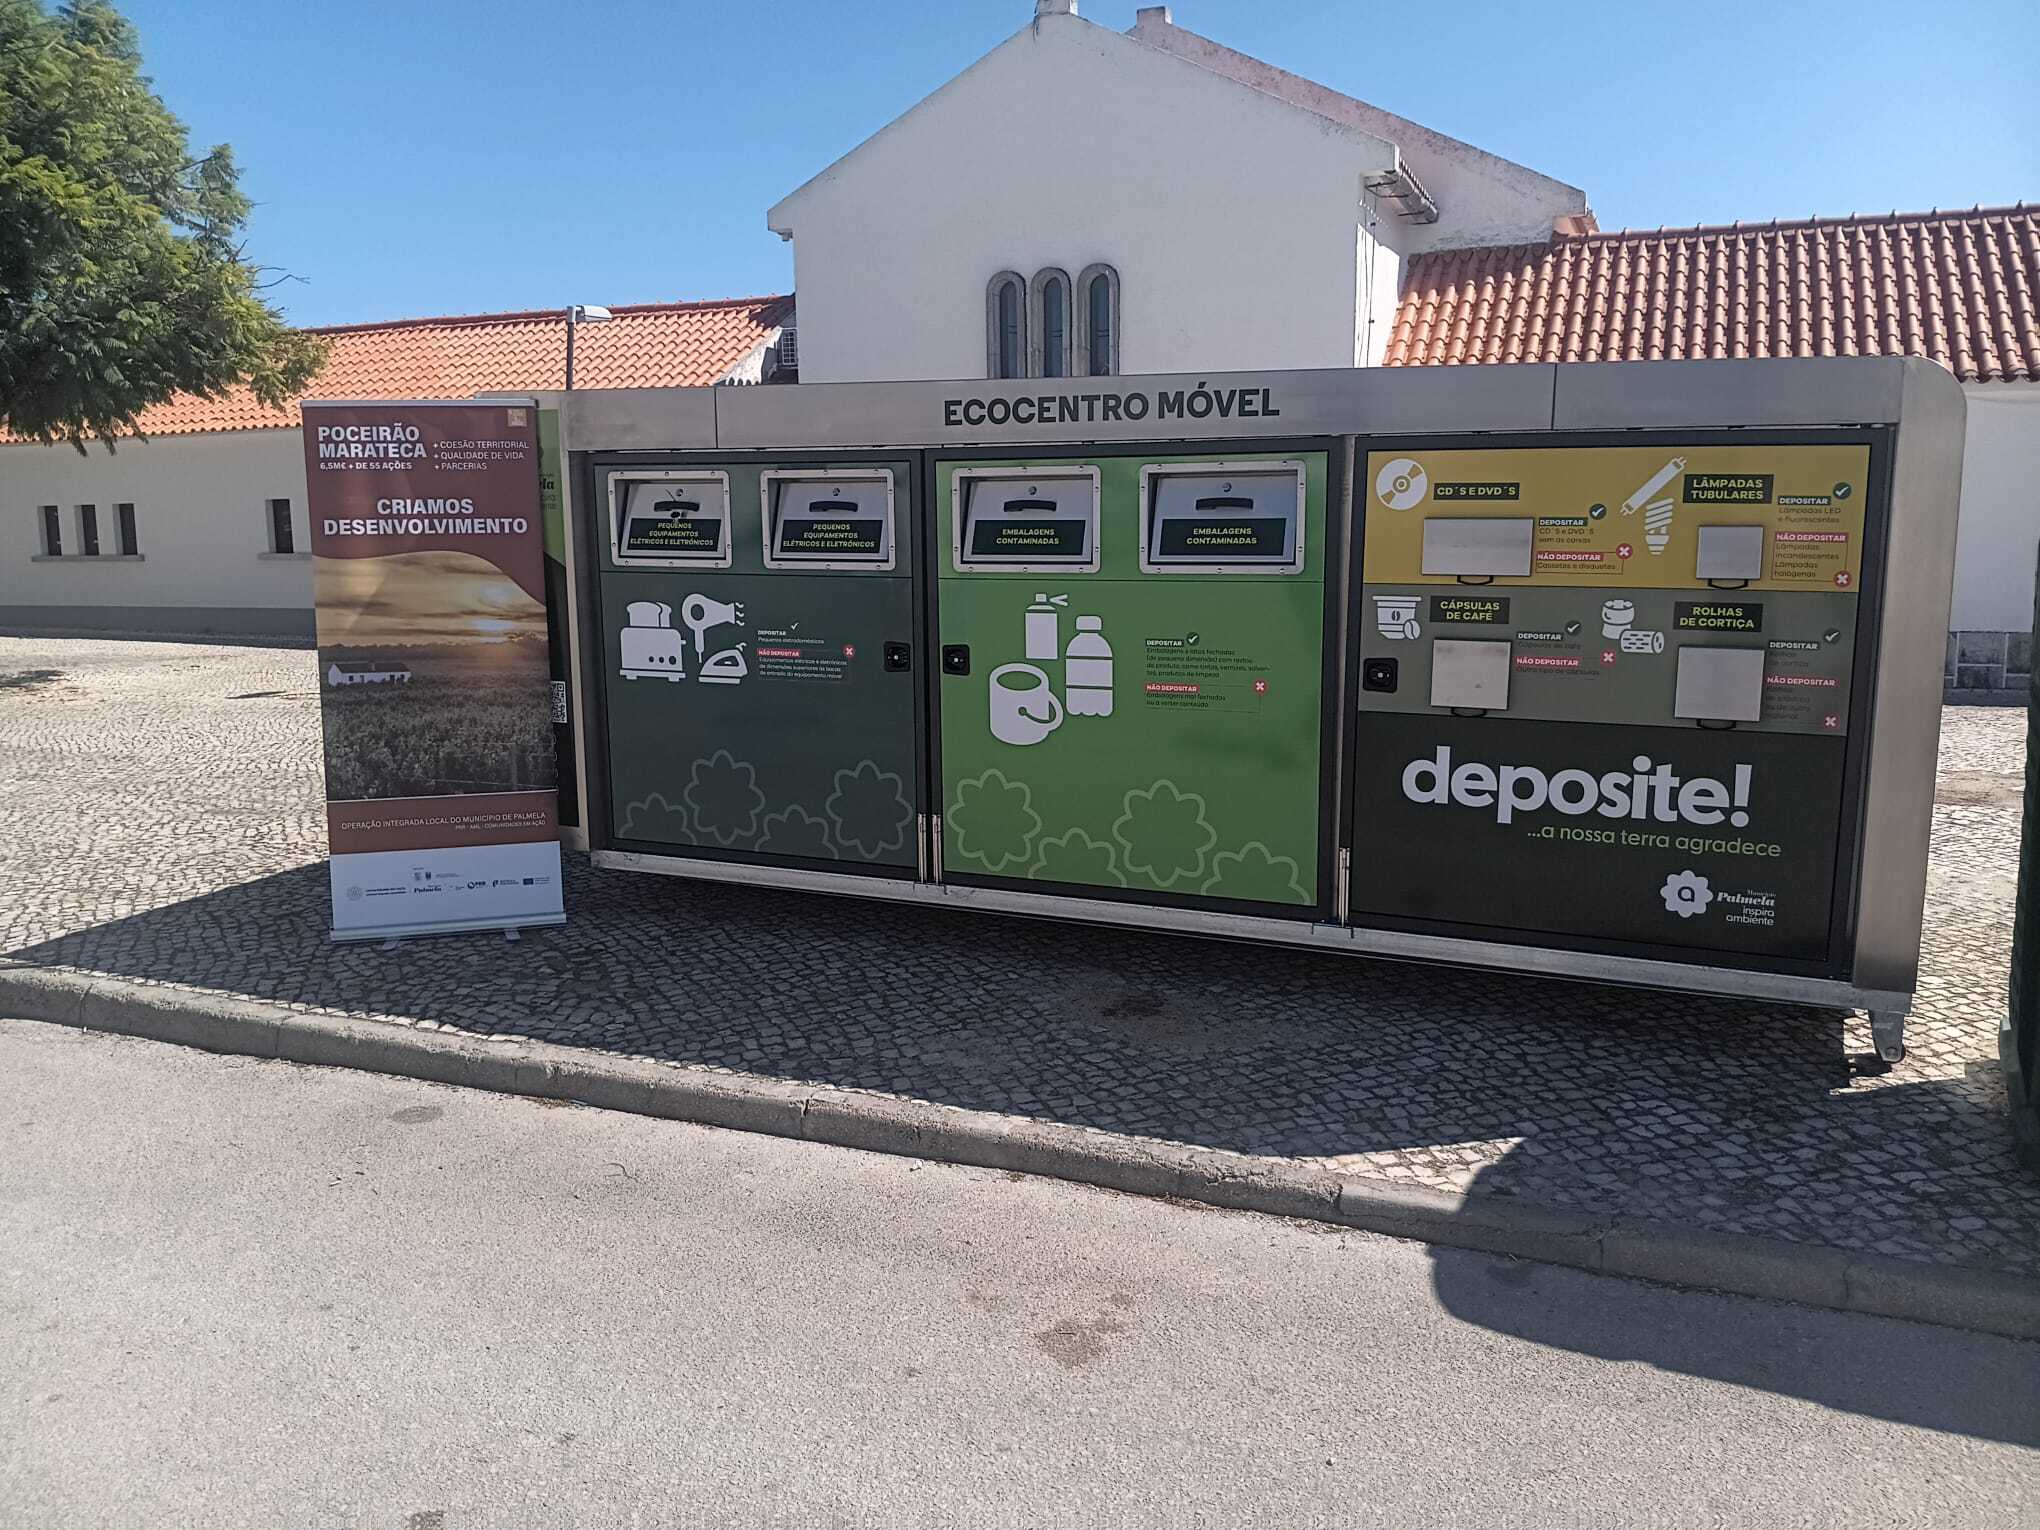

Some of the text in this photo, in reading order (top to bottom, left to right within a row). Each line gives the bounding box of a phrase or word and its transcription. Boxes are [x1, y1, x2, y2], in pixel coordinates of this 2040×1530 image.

[944, 382, 1280, 426] ECOCENTRO MÓVEL
[318, 423, 421, 441] POCEIRÃO
[440, 440, 475, 449] COESÃO
[476, 440, 530, 449] TERRITORIAL
[319, 443, 428, 458] MARATECA
[440, 451, 489, 460] QUALIDADE
[491, 451, 503, 459] DE
[504, 451, 526, 459] VIDA
[355, 462, 368, 470] DE
[382, 460, 413, 472] AÇÕES
[441, 462, 488, 471] PARCERIAS
[1693, 477, 1763, 488] LÂMPADAS
[1469, 487, 1476, 496] E
[1691, 490, 1763, 500] TUBULARES
[377, 498, 474, 515] CRIAMOS
[323, 518, 528, 536] DESENVOLVIMENTO
[658, 522, 692, 530] PEQUENOS
[630, 537, 664, 545] ELÉTRICOS
[670, 538, 713, 546] ELETRÓNICOS
[996, 537, 1060, 545] CONTAMINADAS
[1186, 537, 1257, 545] CONTAMINADAS
[1777, 533, 1846, 542] NÃO DEPOSITAR
[783, 539, 820, 547] ELÉTRICOS
[826, 540, 875, 548] ELETRÓNICOS
[1537, 553, 1601, 562] NÃO DEPOSITAR
[1440, 599, 1500, 611] CÁPSULAS
[1446, 610, 1493, 621] DE CAFÉ
[1692, 607, 1743, 617] ROLHAS
[1680, 617, 1754, 629] DE CORTIÇA
[1518, 633, 1562, 641] DEPOSITAR
[1769, 641, 1818, 650] DEPOSITAR
[1516, 656, 1579, 666] NÃO DEPOSITAR
[1767, 676, 1836, 687] NÃO DEPOSITAR
[1401, 745, 1753, 828] deposite!
[341, 819, 382, 831] OPERAÇÃO
[382, 818, 426, 828] INTEGRADA
[425, 817, 449, 825] LOCAL
[462, 813, 501, 823] MUNICÍPIO
[502, 813, 514, 821] DE
[513, 811, 546, 820] PALMELA
[1560, 828, 1616, 844] nossa
[1619, 831, 1669, 848] terra
[1675, 835, 1782, 858] agradece
[1716, 892, 1775, 907] Palmela
[1743, 905, 1775, 917] inspira
[1726, 914, 1775, 926] ambiente
